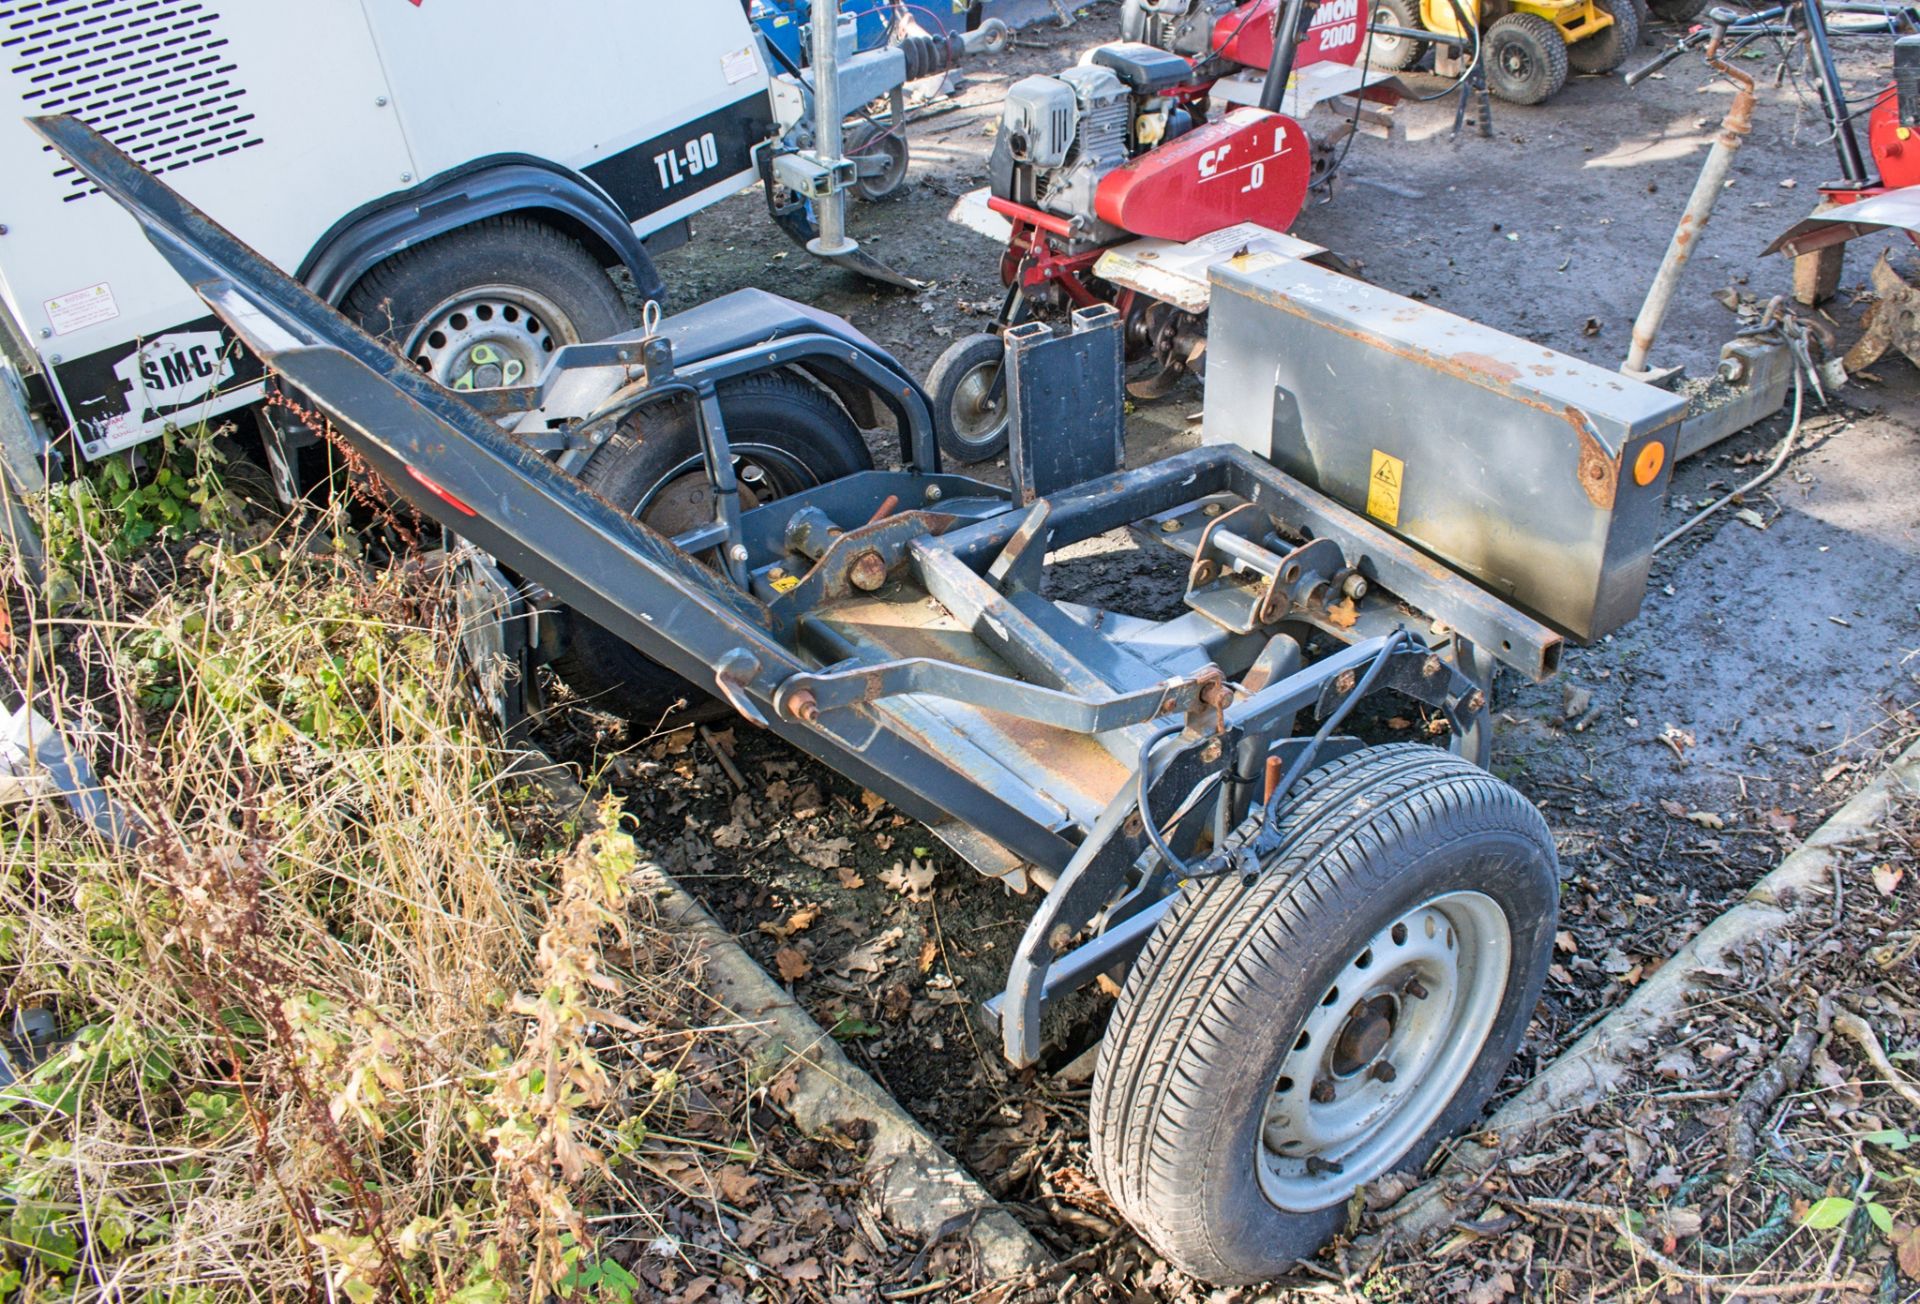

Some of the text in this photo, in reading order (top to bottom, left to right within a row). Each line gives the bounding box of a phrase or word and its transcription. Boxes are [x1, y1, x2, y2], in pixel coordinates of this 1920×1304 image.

[1320, 22, 1357, 51] 2000
[653, 132, 719, 190] TL-90
[141, 344, 213, 390] SMC
